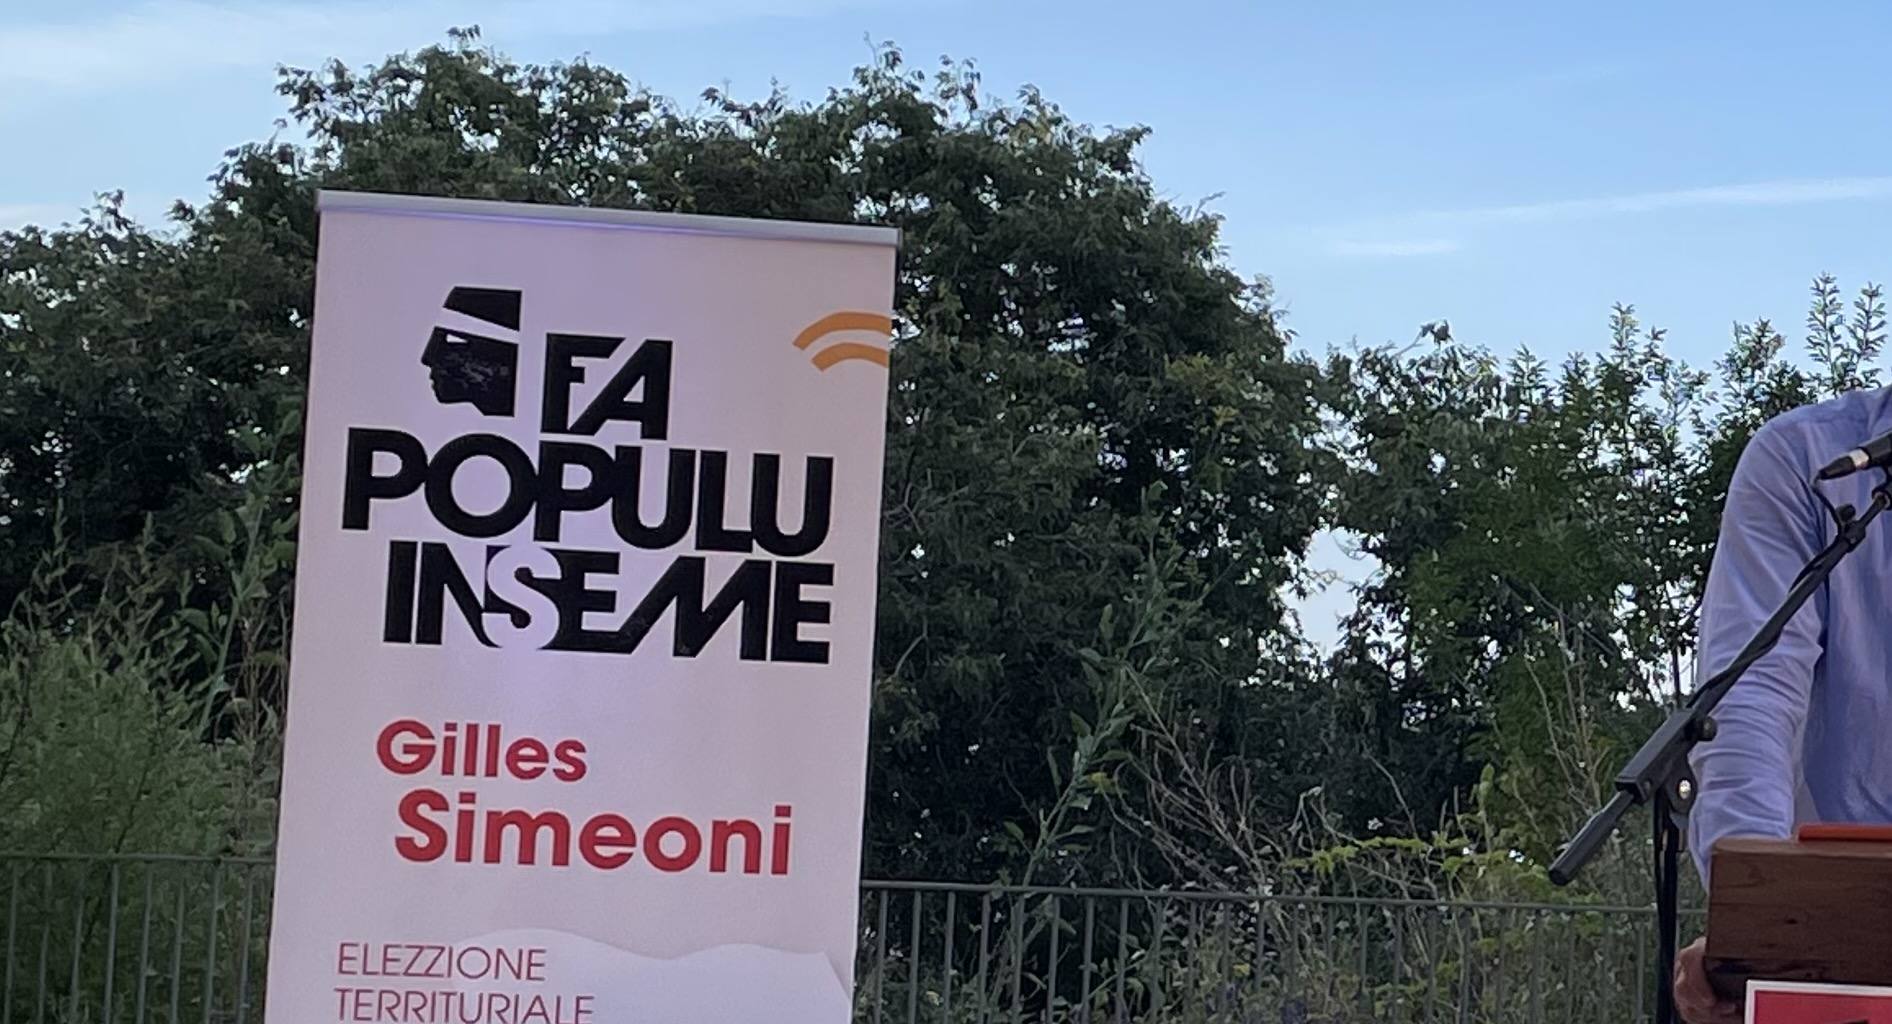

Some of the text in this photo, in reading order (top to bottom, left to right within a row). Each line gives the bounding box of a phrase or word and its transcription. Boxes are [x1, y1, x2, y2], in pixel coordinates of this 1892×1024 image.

[541, 333, 673, 440] FA
[342, 427, 834, 557] POPULU
[383, 540, 835, 664] INSEME
[376, 719, 587, 782] Gilles
[395, 788, 792, 875] Simeoni
[337, 942, 546, 982] ELEZZIONE
